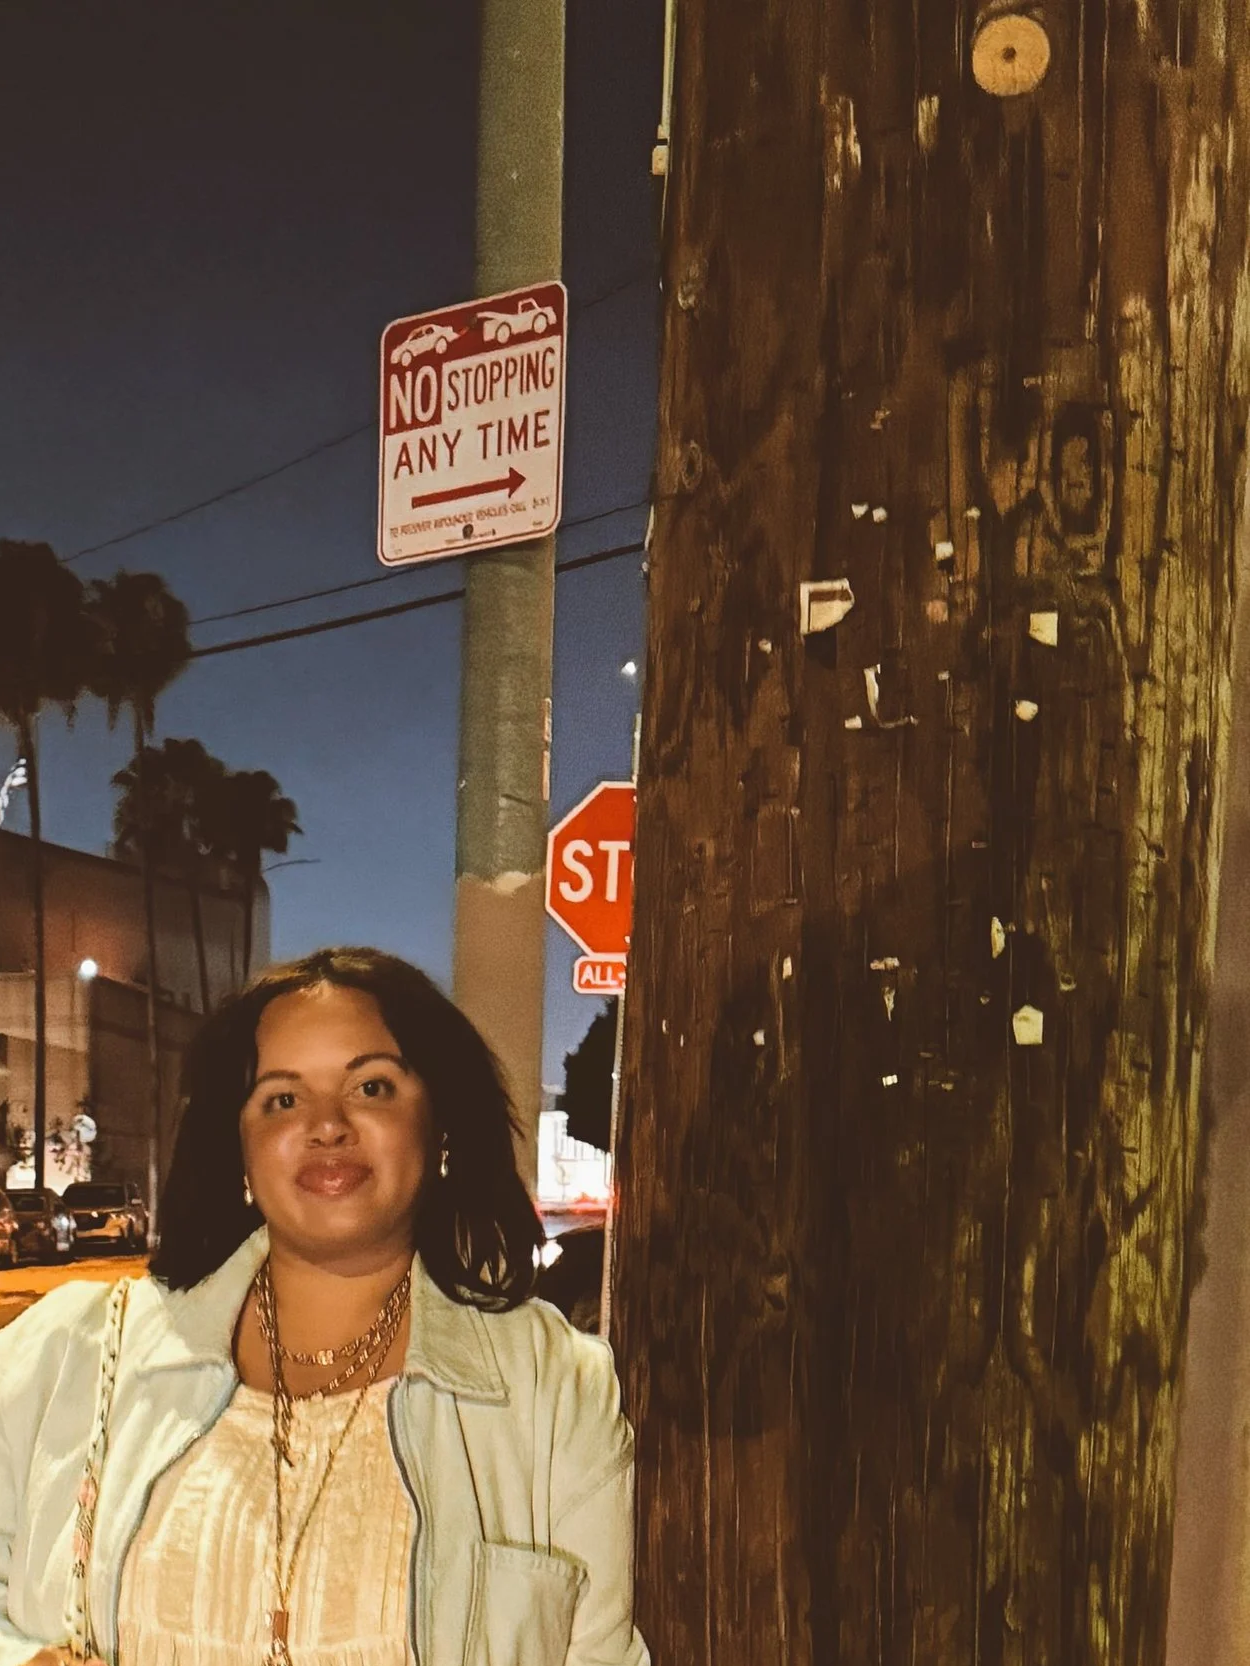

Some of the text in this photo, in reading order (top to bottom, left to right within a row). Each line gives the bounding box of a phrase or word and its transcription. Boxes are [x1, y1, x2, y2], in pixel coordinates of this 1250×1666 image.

[390, 347, 555, 428] NO STOPPING
[394, 410, 550, 480] ANY TIME
[558, 839, 634, 902] ST
